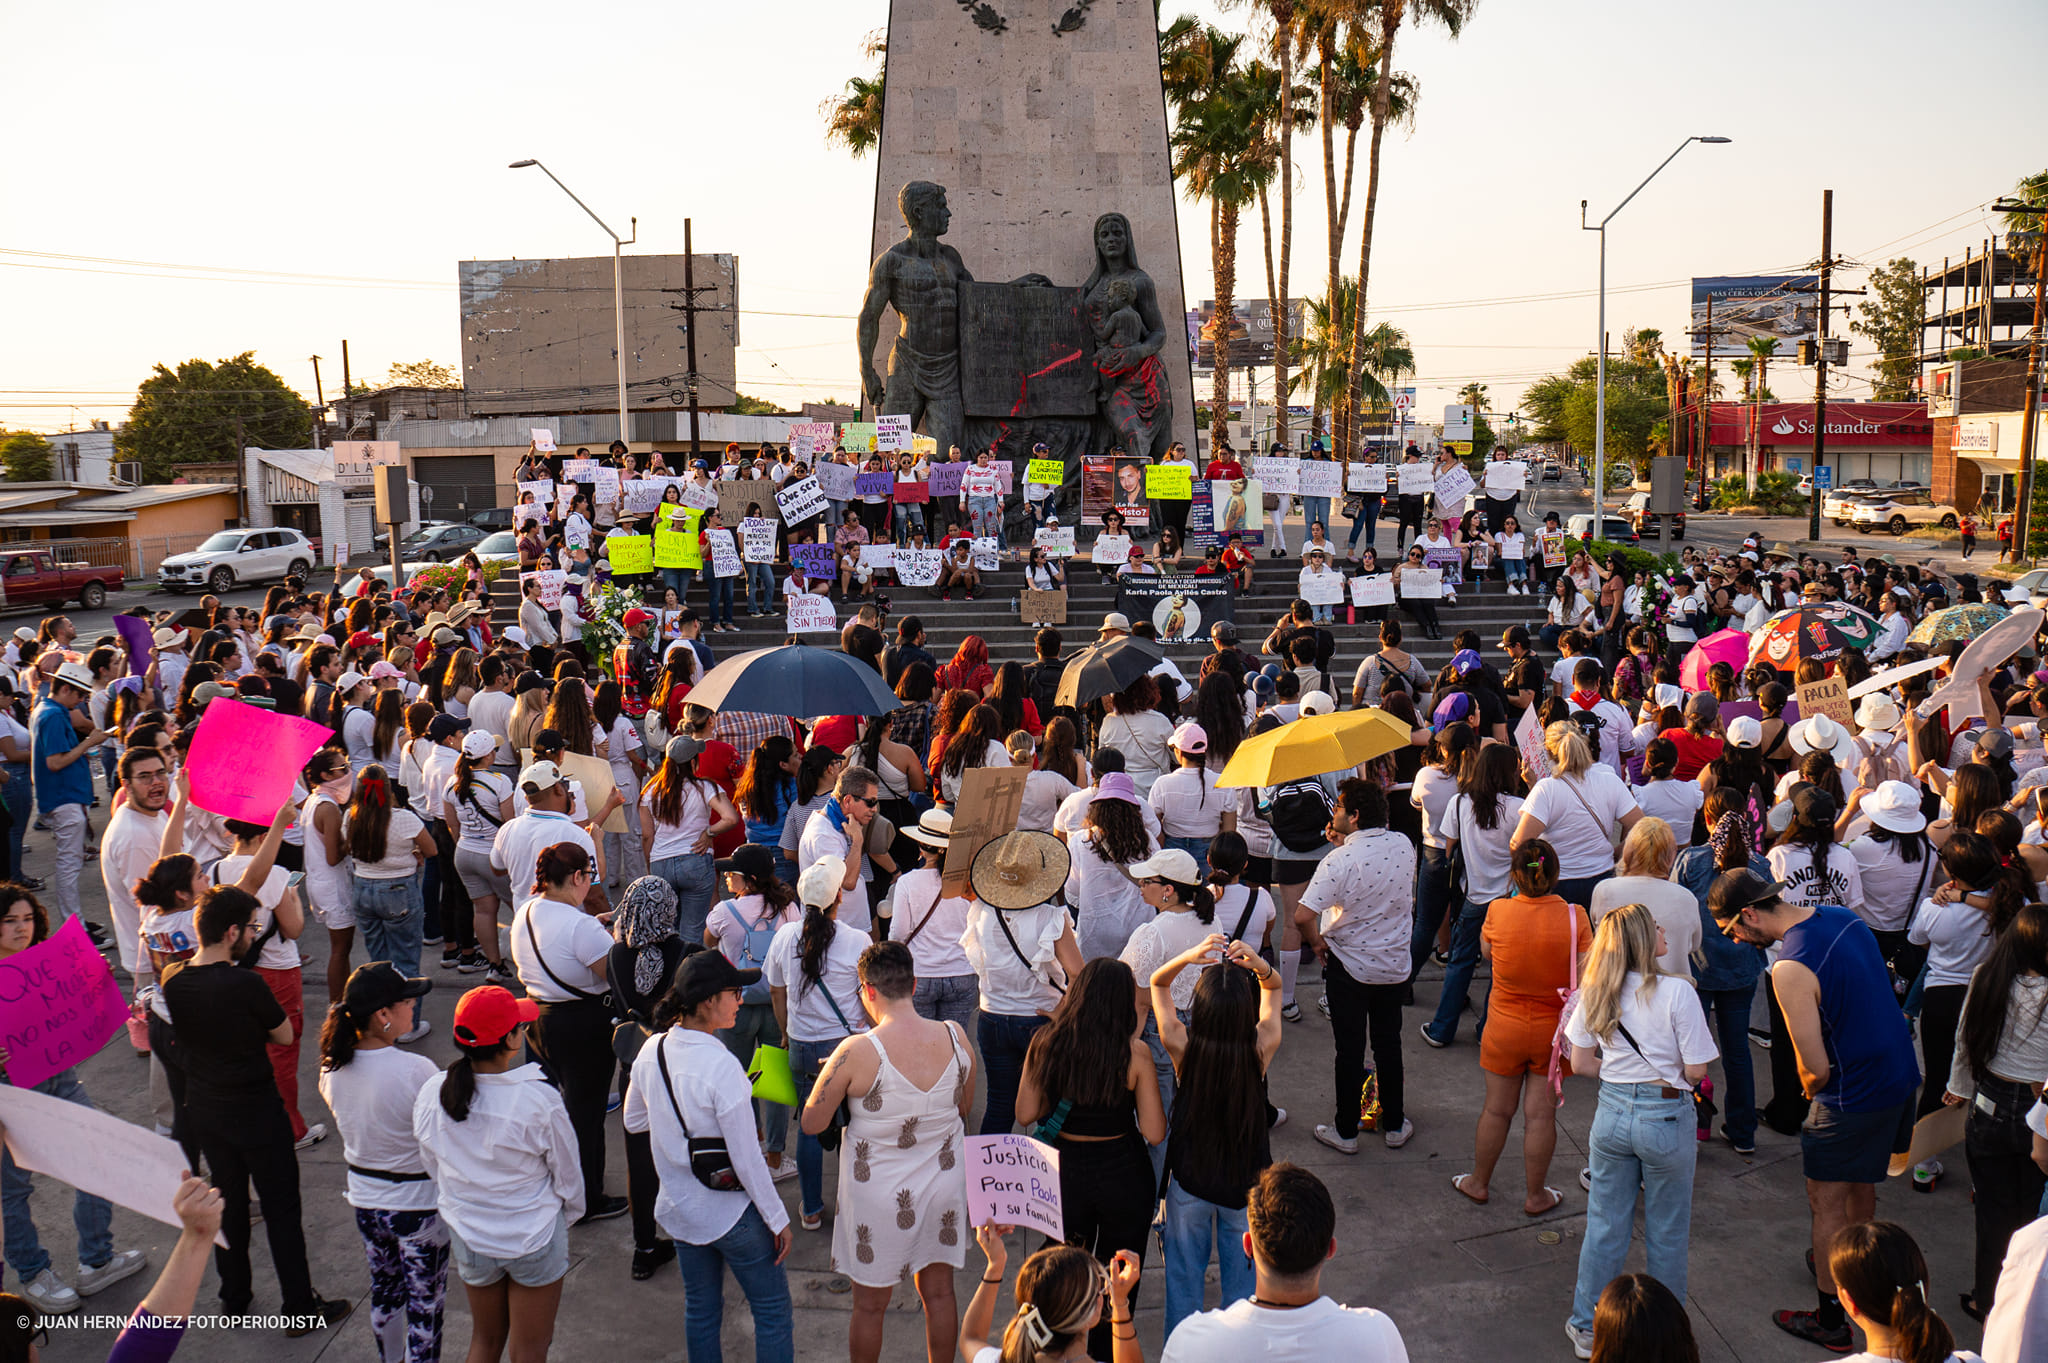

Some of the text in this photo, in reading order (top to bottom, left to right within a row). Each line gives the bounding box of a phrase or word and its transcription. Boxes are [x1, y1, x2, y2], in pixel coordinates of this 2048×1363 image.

[1797, 418, 1881, 435] Satander
[862, 484, 888, 493] VIVA
[1264, 484, 1298, 492] JUSTICIA
[1118, 507, 1147, 517] visto?
[1200, 588, 1228, 596] Castro
[789, 608, 821, 617] CRECER
[794, 615, 836, 629] SIN MIEDO!
[1804, 683, 1842, 703] PAOLA
[6, 1025, 39, 1054] NO
[45, 1007, 78, 1033] NOS
[44, 1040, 75, 1066] LA
[980, 1143, 1048, 1174] Justicia
[980, 1175, 1058, 1207] Para Paola
[990, 1202, 1058, 1230] y su familia
